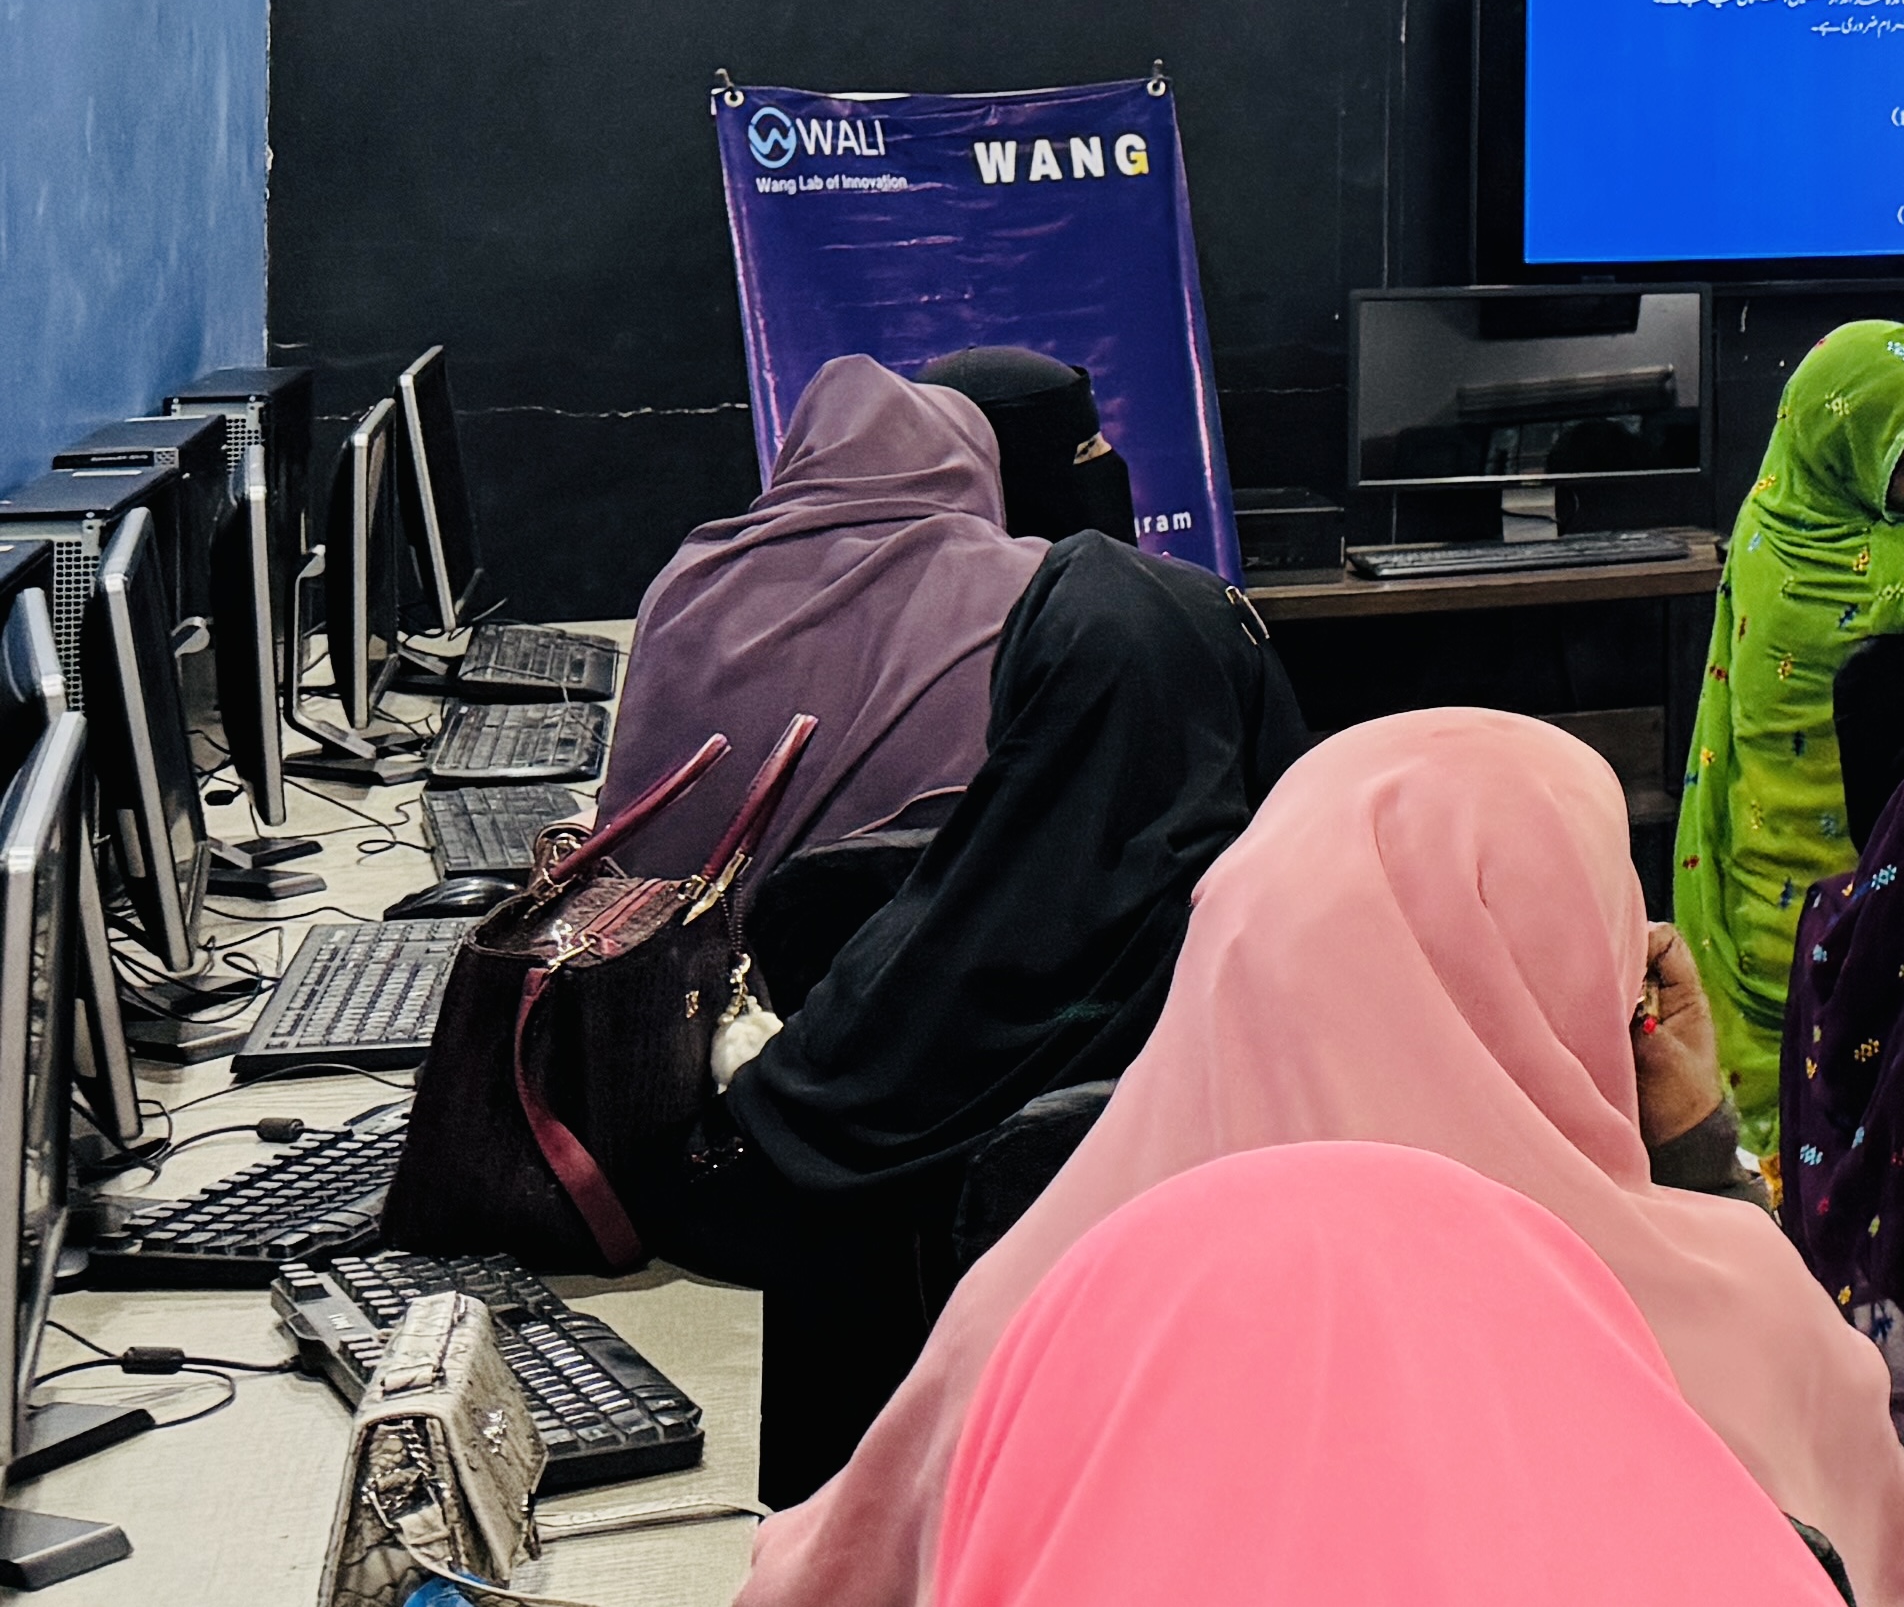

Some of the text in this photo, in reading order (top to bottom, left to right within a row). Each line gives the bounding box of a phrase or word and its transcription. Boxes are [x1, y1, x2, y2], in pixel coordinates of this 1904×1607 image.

[796, 118, 886, 156] WALI
[974, 134, 1150, 184] WANG
[755, 173, 909, 195] Wang Lab of Innovation
[1134, 511, 1192, 538] ram
